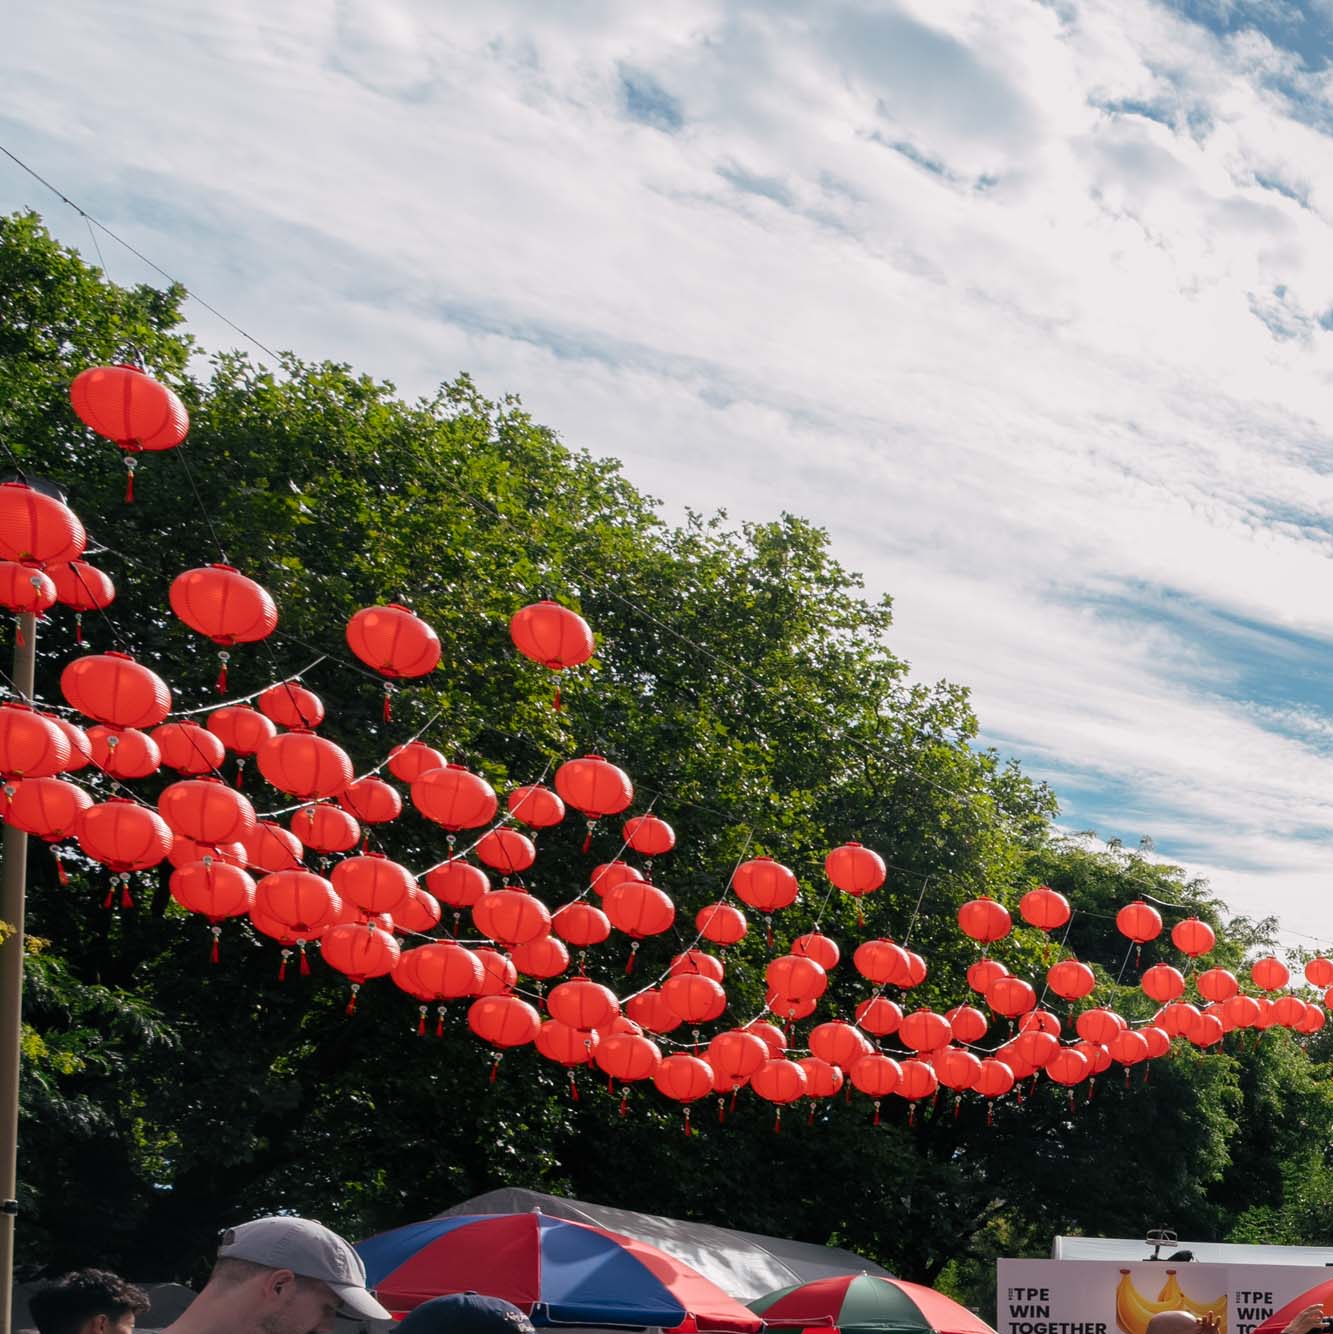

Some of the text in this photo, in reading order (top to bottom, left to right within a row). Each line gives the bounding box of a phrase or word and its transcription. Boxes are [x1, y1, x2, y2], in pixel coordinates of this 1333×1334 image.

[1014, 1288, 1050, 1301] TPE
[1241, 1291, 1273, 1304] TPE
[1009, 1305, 1050, 1318] WIN
[1237, 1307, 1274, 1321] WIN
